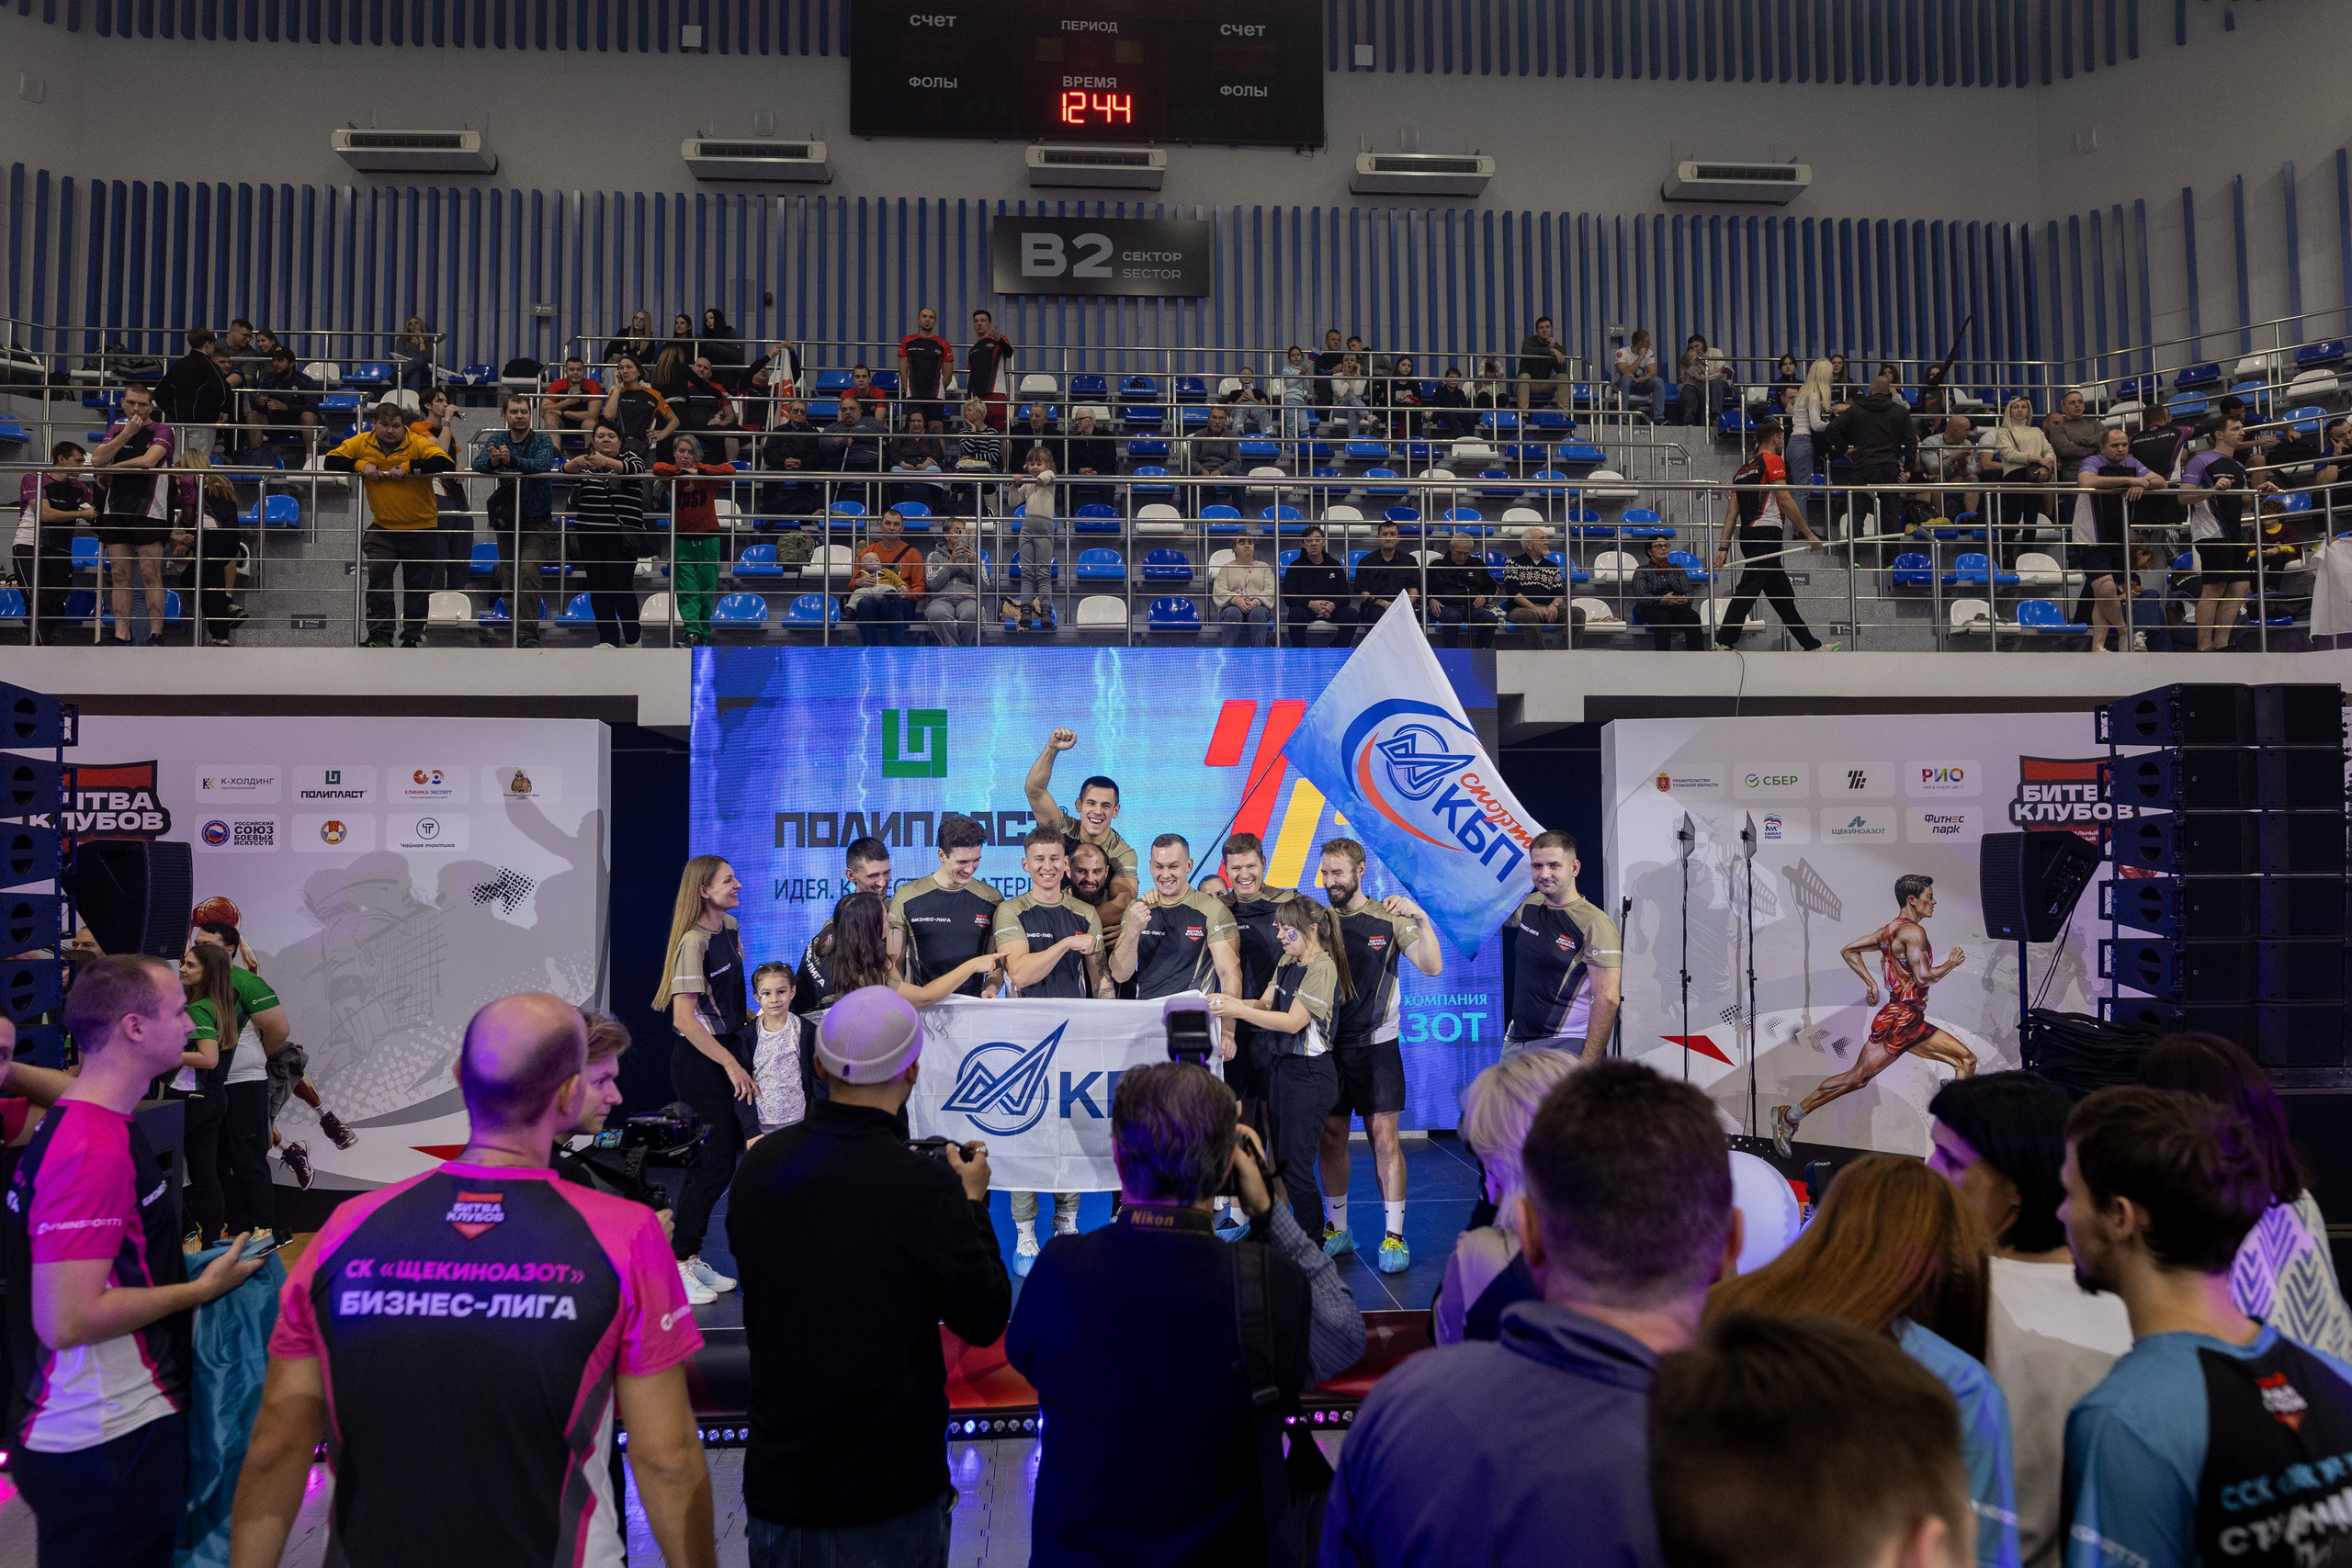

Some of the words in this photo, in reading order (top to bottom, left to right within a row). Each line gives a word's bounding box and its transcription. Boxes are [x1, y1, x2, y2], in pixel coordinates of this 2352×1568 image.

[1061, 20, 1118, 33] ПЕРИОД
[909, 76, 957, 89] ФОЛЫ
[1062, 75, 1117, 89] ВРЕМЯ
[1219, 84, 1268, 97] ФОЛЫ
[1122, 251, 1182, 262] СЕКТОР
[1122, 268, 1182, 279] SECTOR
[1763, 775, 1798, 785] СБЕР
[1922, 768, 1964, 783] РИО
[2015, 802, 2134, 822] КЛУБОВ
[1431, 783, 1525, 883] КБП
[775, 879, 834, 903] ИДЕЯ.
[1404, 994, 1487, 1006] КОМПАНИЯ
[453, 1202, 503, 1213] БИТВА
[446, 1212, 505, 1223] КЛУБОВ
[1130, 1210, 1174, 1227] Nikon
[345, 1258, 376, 1279] СК
[379, 1259, 585, 1284] «ЩЕКИНОАЗОТ»
[338, 1290, 578, 1321] БИЗНЕС-ЛИГА
